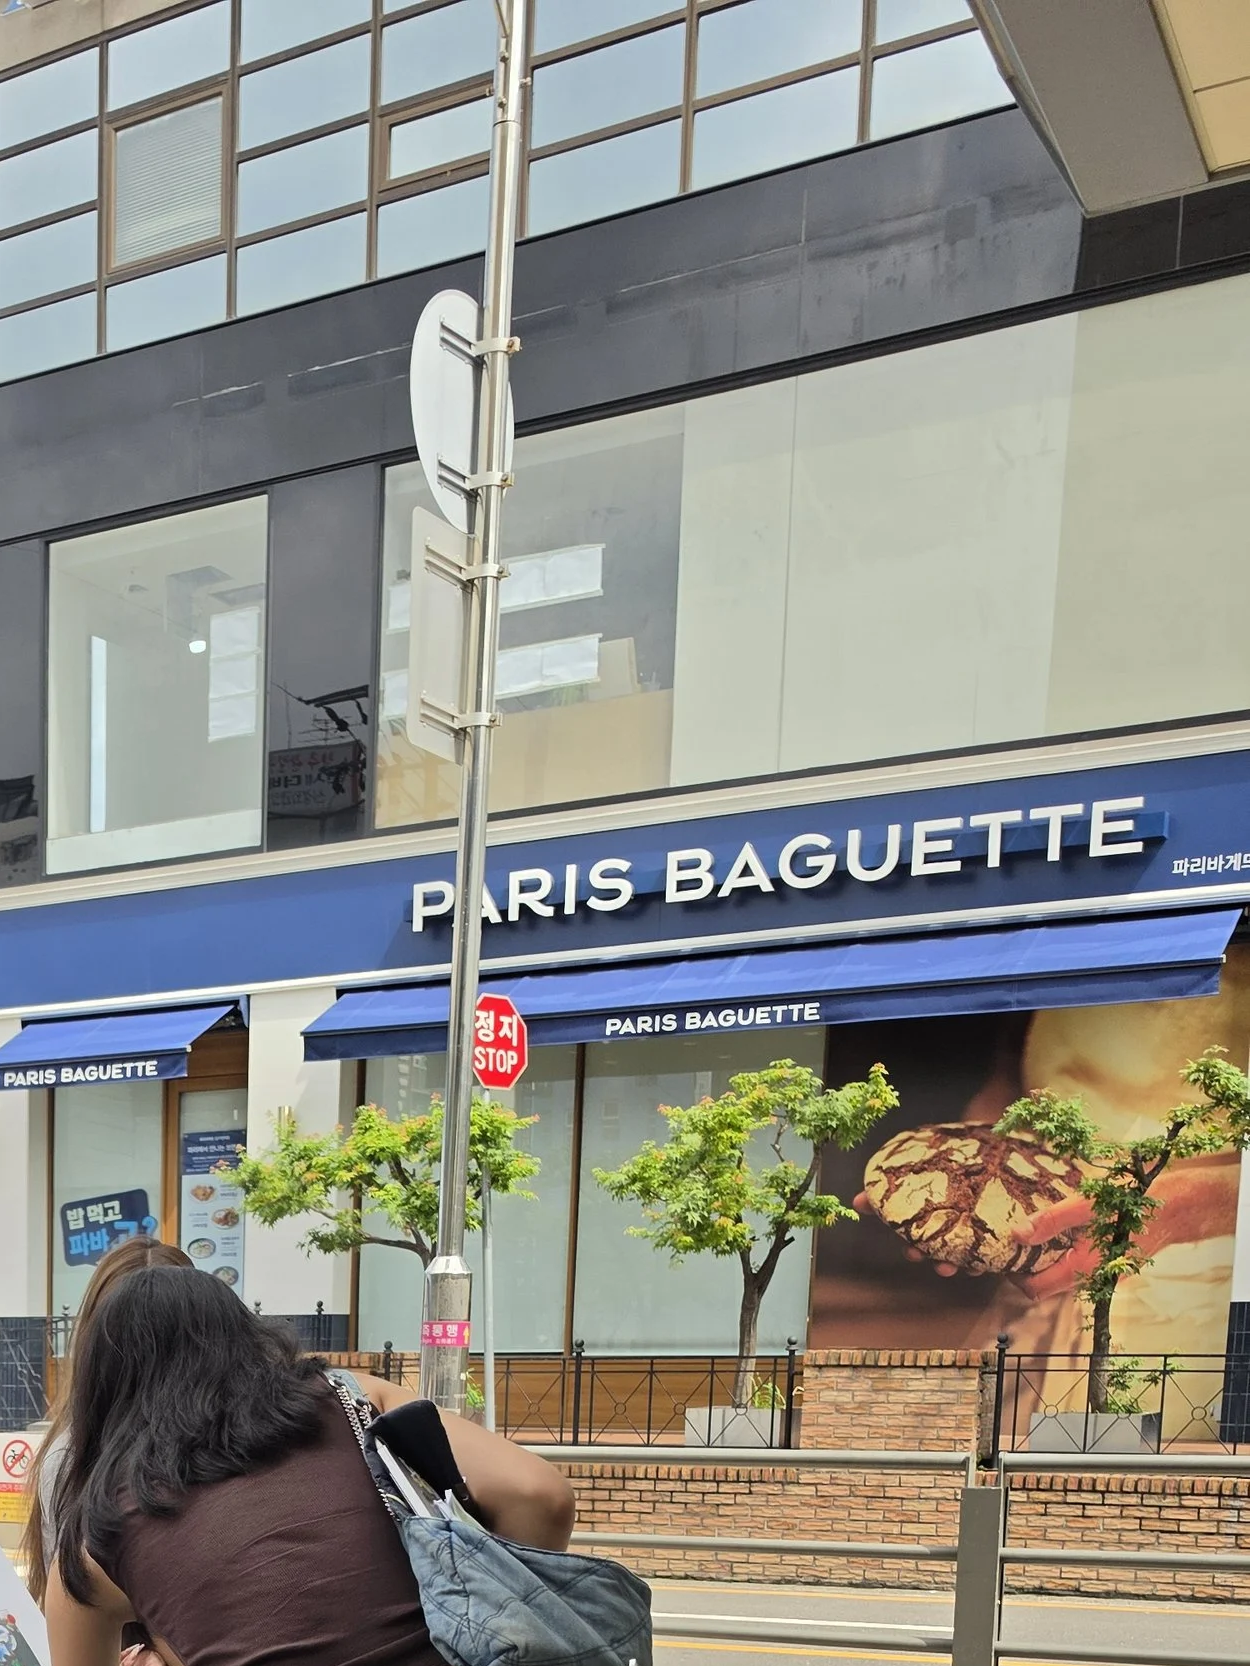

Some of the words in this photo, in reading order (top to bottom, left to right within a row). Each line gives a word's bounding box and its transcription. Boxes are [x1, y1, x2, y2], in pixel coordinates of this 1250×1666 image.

[665, 796, 1144, 904] BAGUETTE
[474, 1010, 518, 1047] 정지
[605, 1013, 677, 1036] PARIS
[684, 1002, 820, 1030] BAGUETTE
[3, 1068, 56, 1087] PARIS
[60, 1060, 158, 1083] BAGUETTE
[474, 1046, 518, 1074] STOP
[66, 1207, 85, 1230] 밥
[86, 1200, 123, 1224] 먹고
